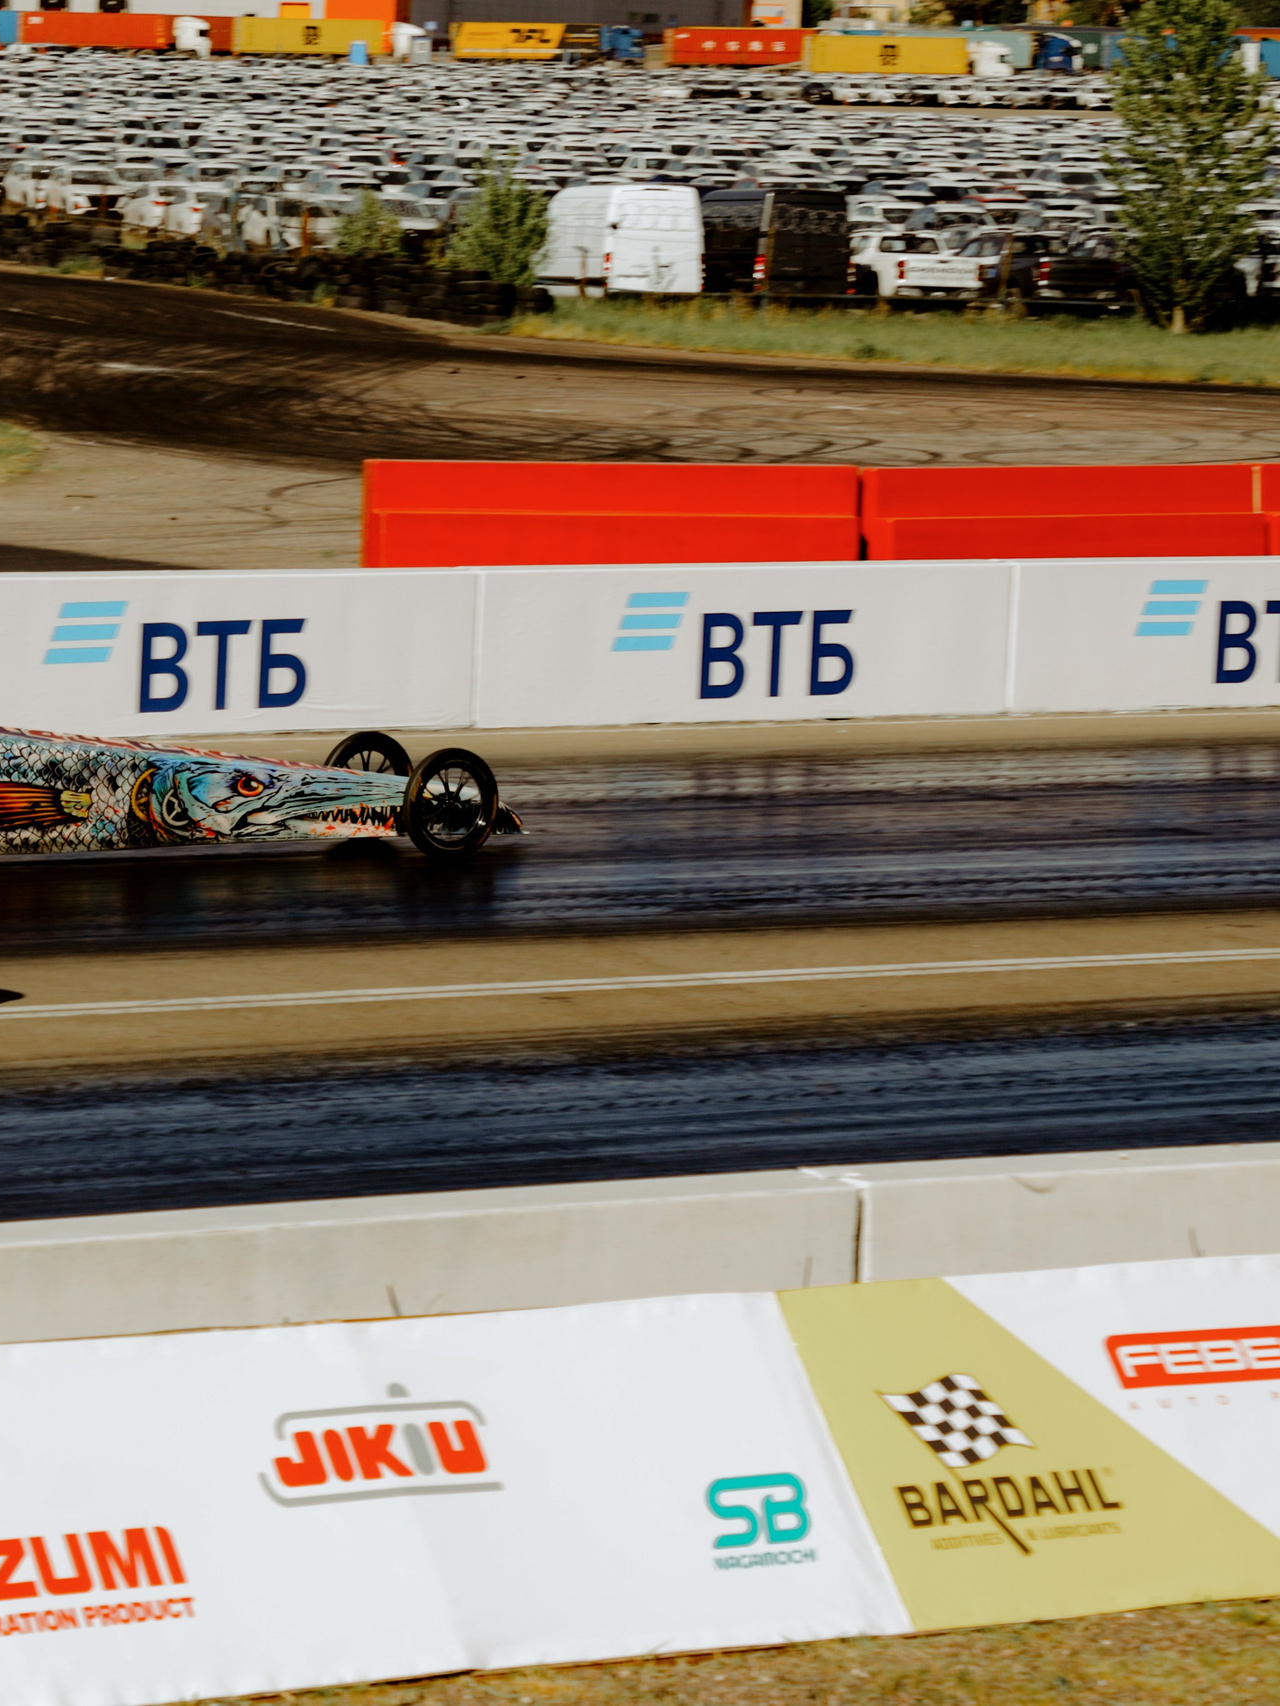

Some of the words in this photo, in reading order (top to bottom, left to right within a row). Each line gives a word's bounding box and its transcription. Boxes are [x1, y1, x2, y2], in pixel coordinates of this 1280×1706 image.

[138, 618, 308, 714] ВТБ
[697, 609, 855, 700] ВТБ
[274, 1420, 487, 1487] JIKIU
[706, 1472, 812, 1549] SB
[895, 1468, 1124, 1528] BARDAHL
[81, 1596, 196, 1628] PRODUCT
